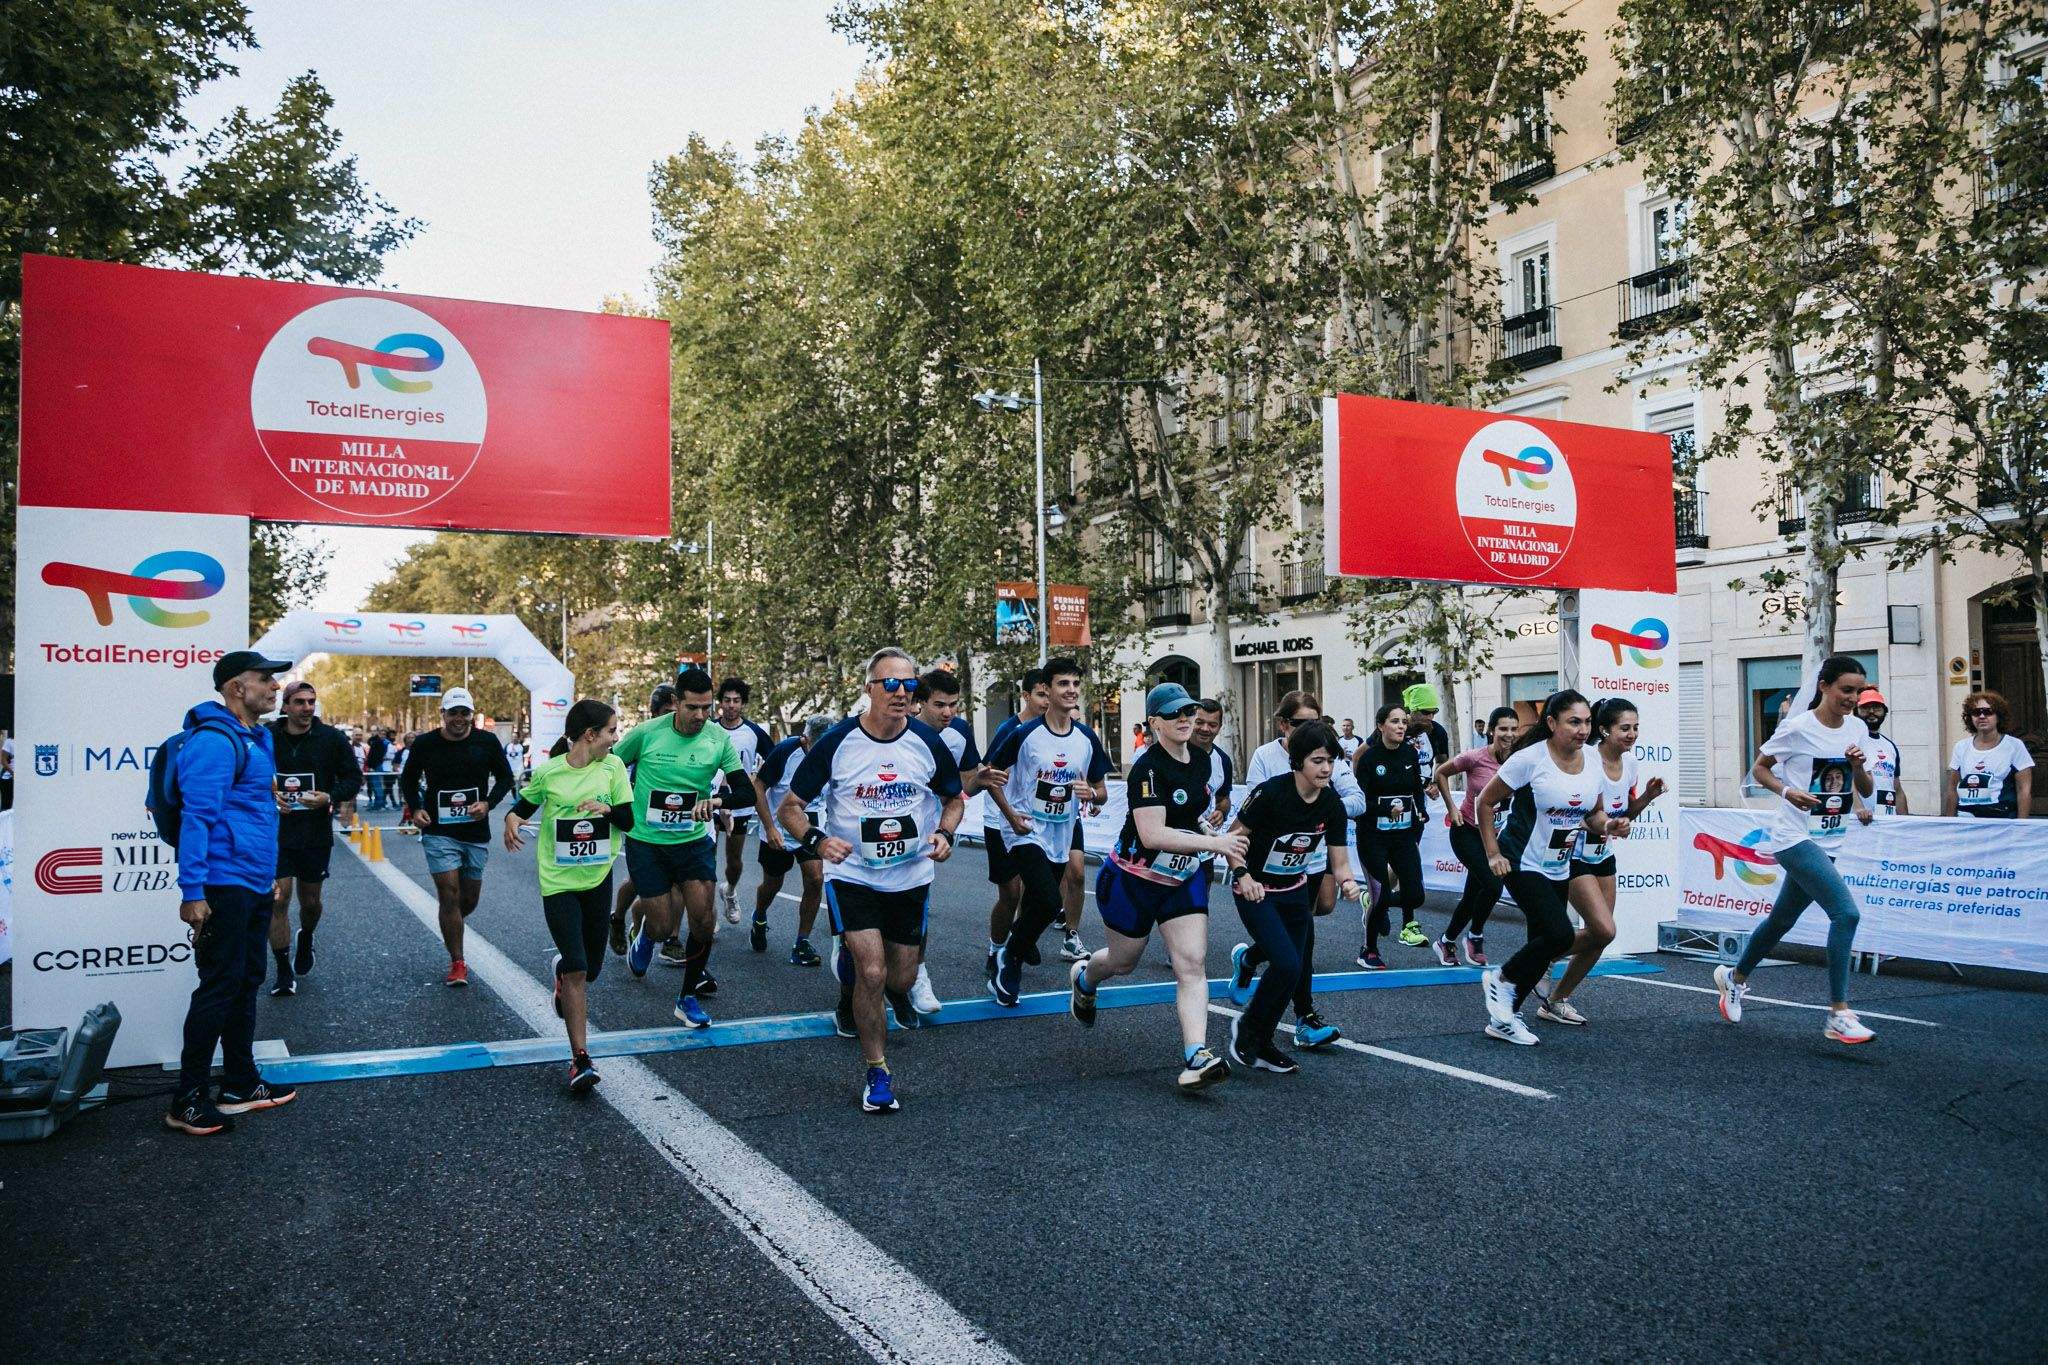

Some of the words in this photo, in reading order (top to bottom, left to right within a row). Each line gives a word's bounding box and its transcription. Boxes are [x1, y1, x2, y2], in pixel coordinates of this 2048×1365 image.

[306, 400, 445, 426] TotalEnergies
[340, 441, 407, 460] MILLA
[315, 478, 344, 495] DE
[349, 480, 430, 499] MADRID
[1484, 494, 1555, 514] TotalEnergies
[1503, 524, 1537, 538] MILLA
[1490, 551, 1506, 563] DE
[1508, 552, 1550, 566] MADRID
[40, 643, 225, 669] TotalEnergies
[1235, 640, 1280, 657] MICHAEL
[1282, 636, 1314, 653] KORS
[1591, 676, 1670, 695] TotalEnergies
[1635, 745, 1672, 762] DRID
[661, 810, 683, 824] 521
[1044, 802, 1065, 815] 519
[111, 832, 137, 841] new
[1630, 826, 1671, 840] RBANA
[569, 841, 597, 857] 520
[876, 840, 906, 858] 529
[1880, 860, 1926, 874] Somos
[1931, 863, 1942, 875] la
[1946, 866, 2017, 880] compañía
[1843, 873, 1950, 894] multienergías
[1955, 884, 1982, 896] que
[1683, 890, 1773, 916] TotalEnergie
[1866, 893, 1884, 905] tus
[1888, 896, 1943, 911] carreras
[1947, 902, 2021, 918] preferidas
[33, 942, 192, 972] CORREDO
